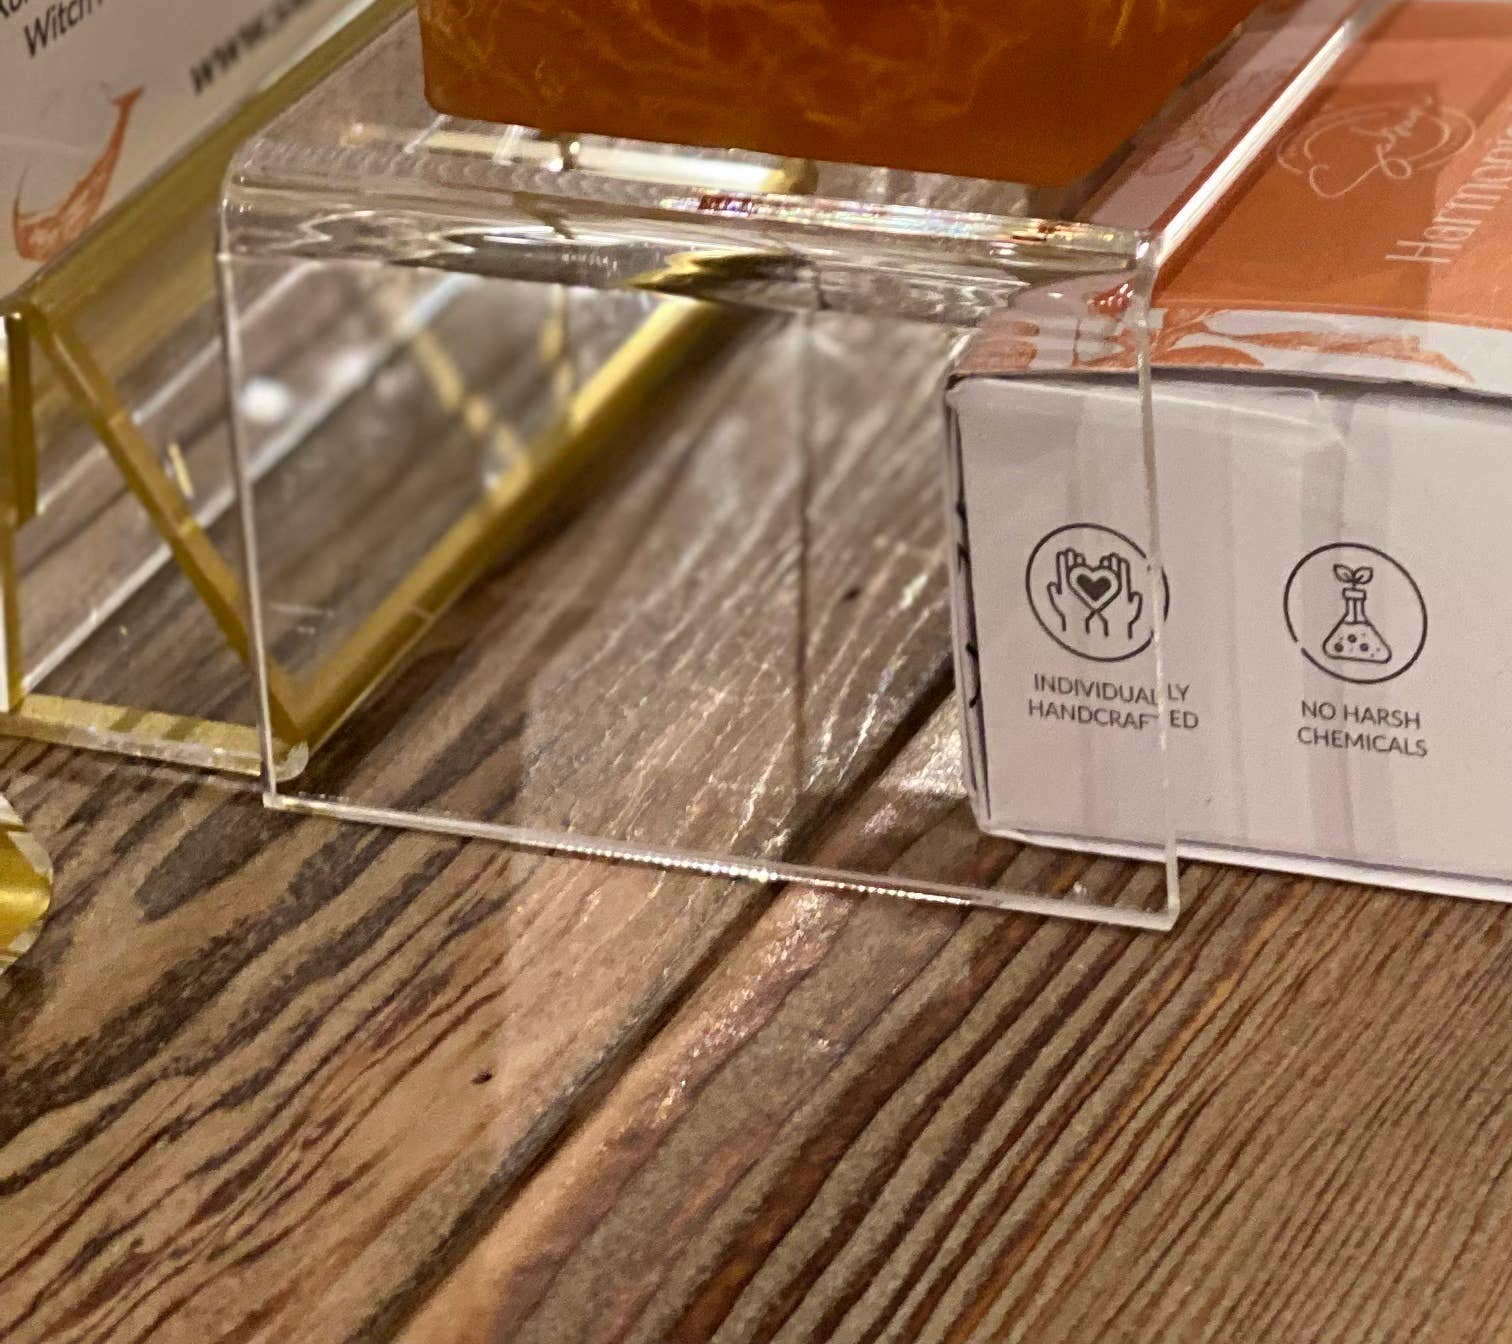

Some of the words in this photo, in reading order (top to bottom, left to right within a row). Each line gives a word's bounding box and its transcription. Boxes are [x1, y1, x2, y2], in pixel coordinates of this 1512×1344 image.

[1033, 672, 1191, 707] INDIVIDUALLY
[1300, 700, 1337, 723] NO
[1341, 703, 1422, 731] HARSH
[1296, 726, 1429, 759] CHEMICALS
